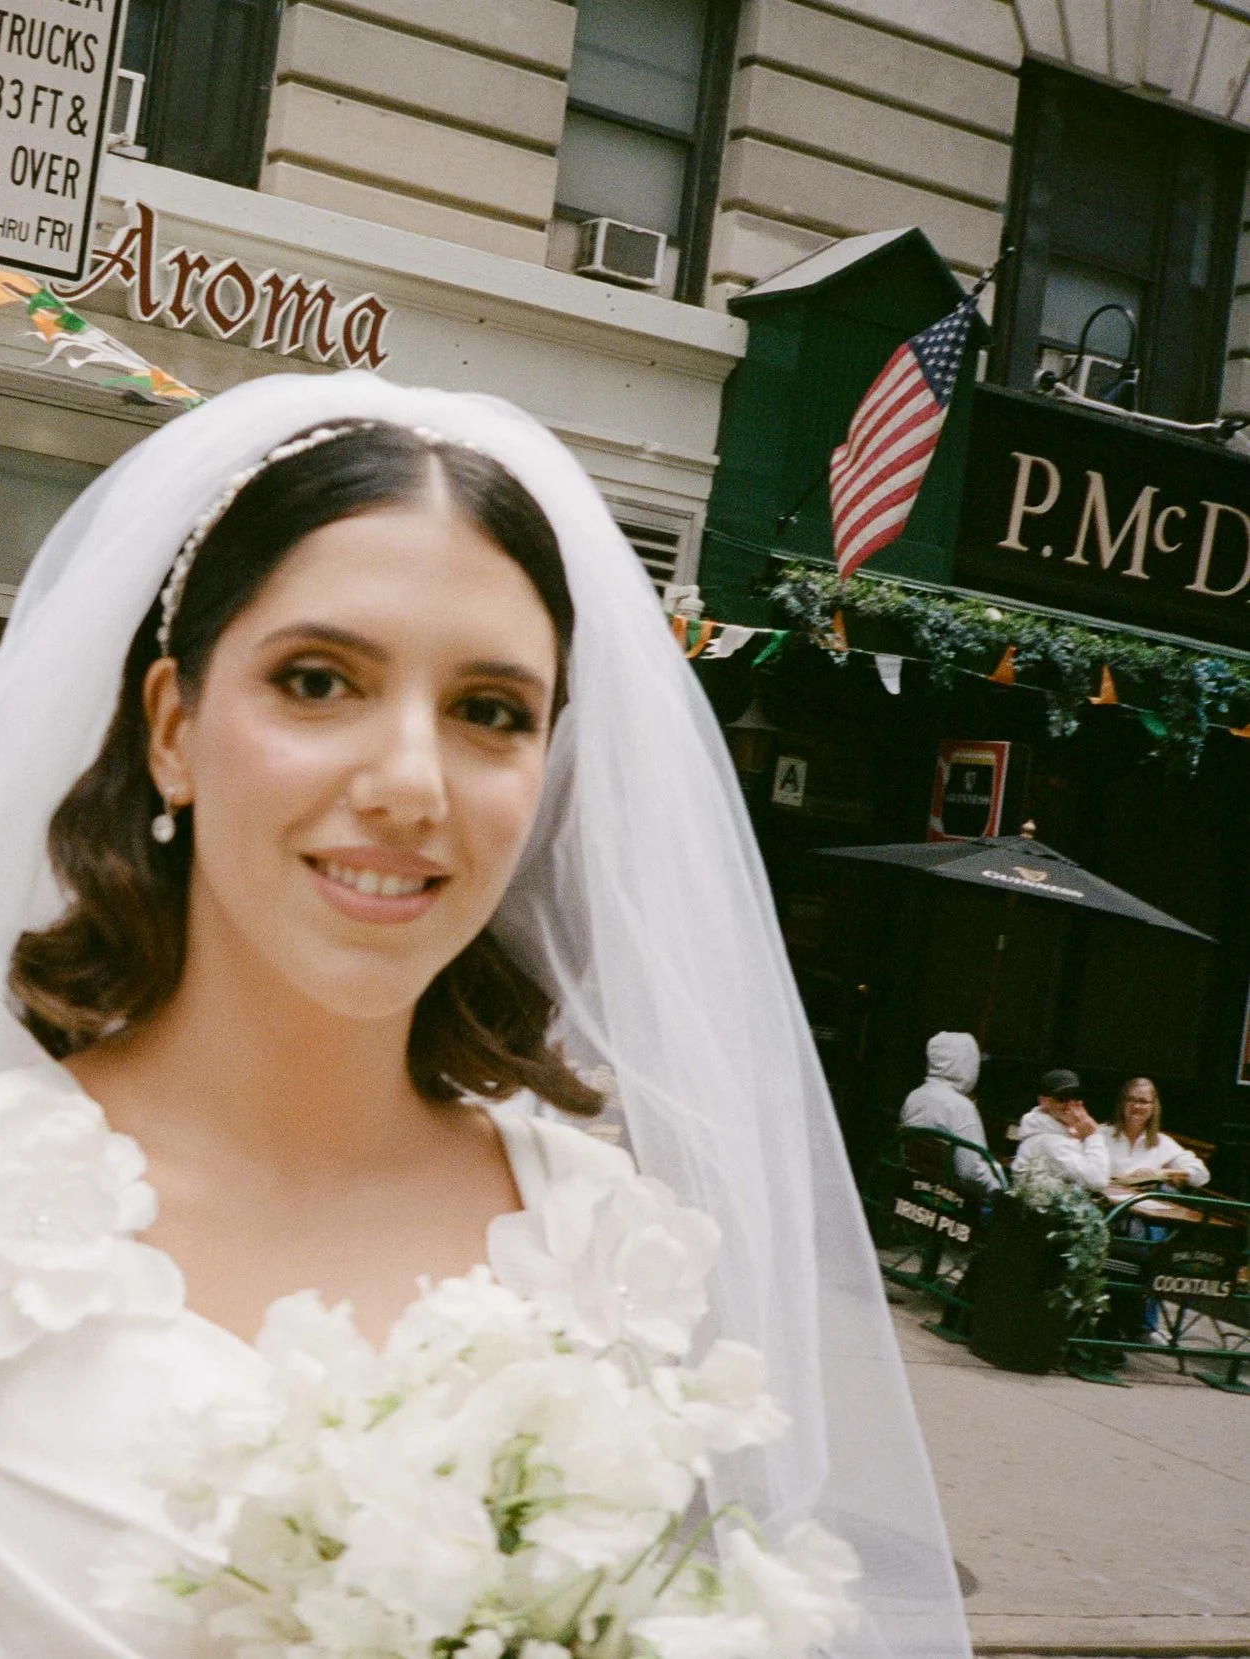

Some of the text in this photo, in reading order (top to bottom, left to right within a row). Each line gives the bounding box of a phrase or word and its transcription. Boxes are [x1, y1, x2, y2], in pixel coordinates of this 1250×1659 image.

[10, 146, 80, 199] OVER
[34, 216, 73, 252] FRI
[49, 199, 391, 371] Aroma
[779, 764, 800, 793] A
[895, 1198, 971, 1242] IRISH PUB
